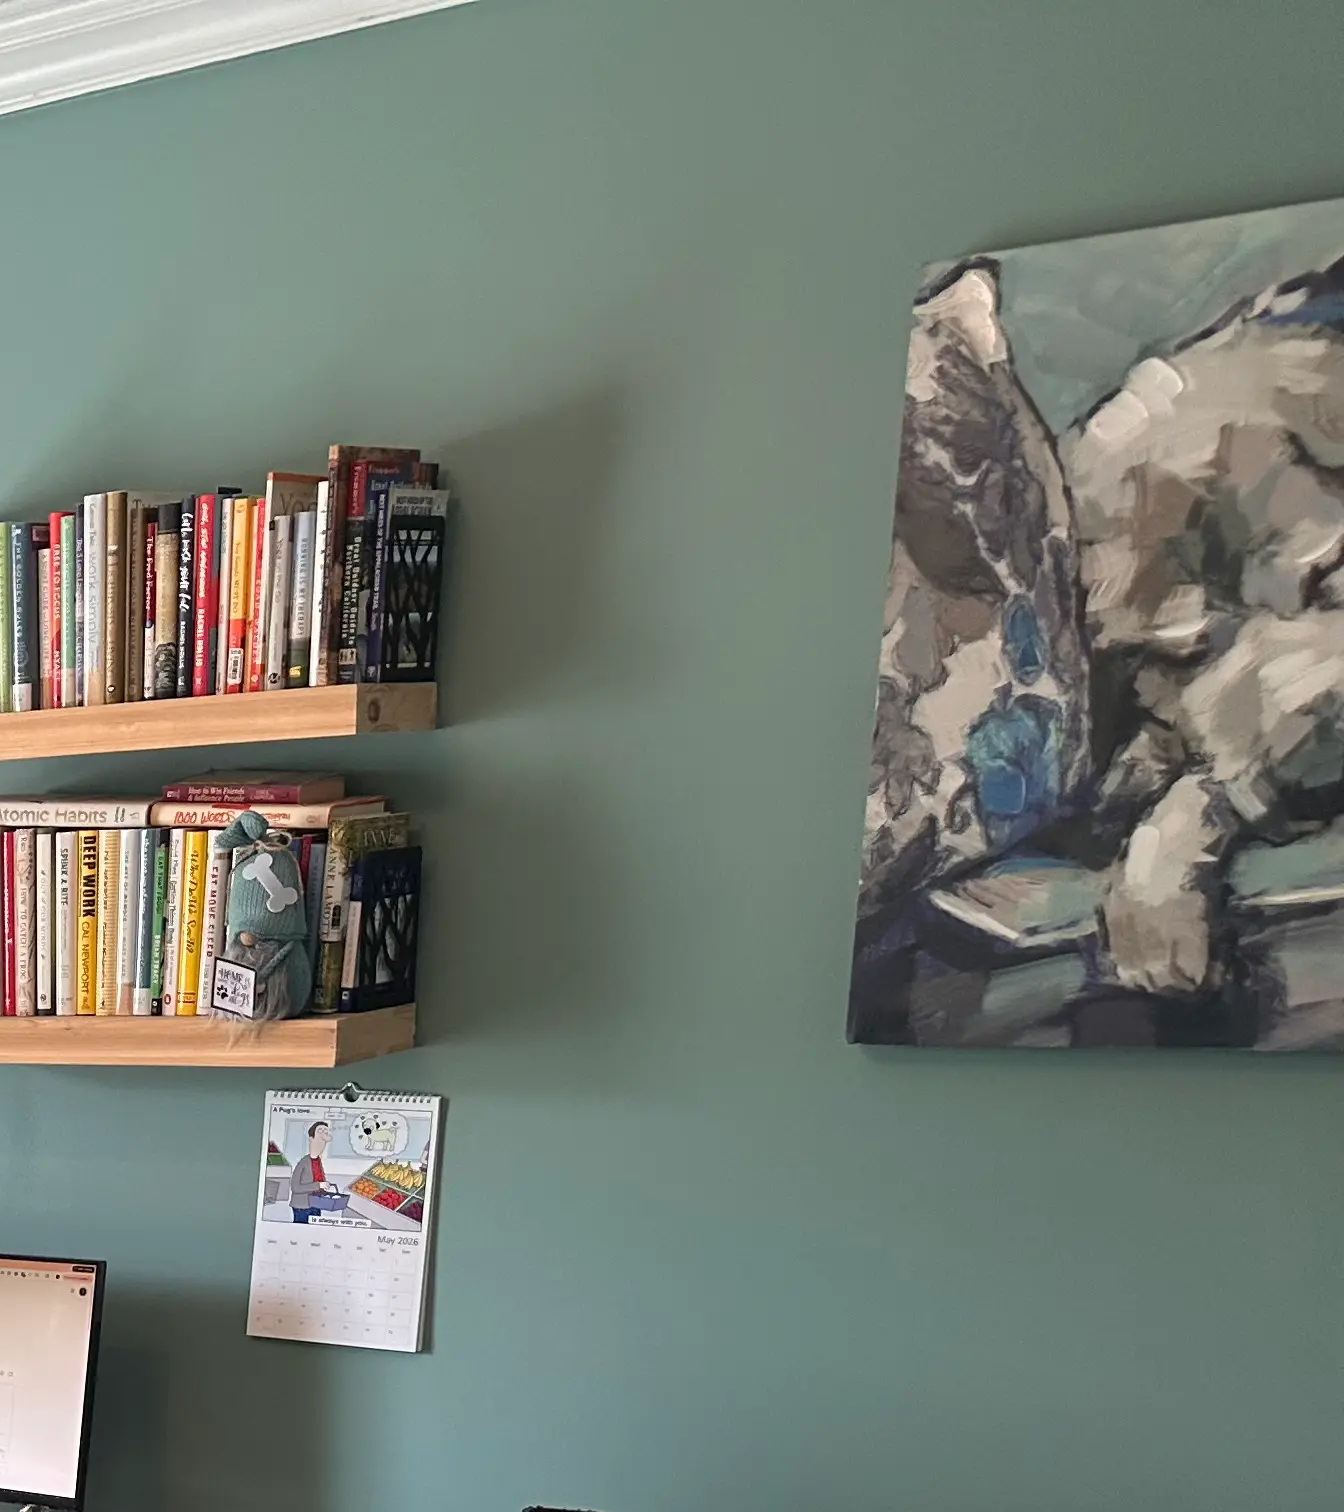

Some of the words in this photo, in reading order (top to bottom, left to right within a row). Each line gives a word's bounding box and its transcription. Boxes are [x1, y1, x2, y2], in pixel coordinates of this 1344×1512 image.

[88, 551, 98, 589] work
[53, 585, 61, 620] FOCUS
[86, 594, 98, 645] simply
[196, 608, 205, 638] RACHEL
[55, 807, 108, 823] Habits
[82, 835, 97, 870] DEEP
[327, 849, 338, 881] ANNE
[210, 867, 219, 884] EAT
[82, 873, 96, 918] WORK
[81, 921, 90, 940] CAL
[322, 885, 333, 942] LAMOTT
[80, 943, 90, 994] NEWPORT
[377, 1235, 395, 1246] May
[397, 1235, 419, 1247] 2026
